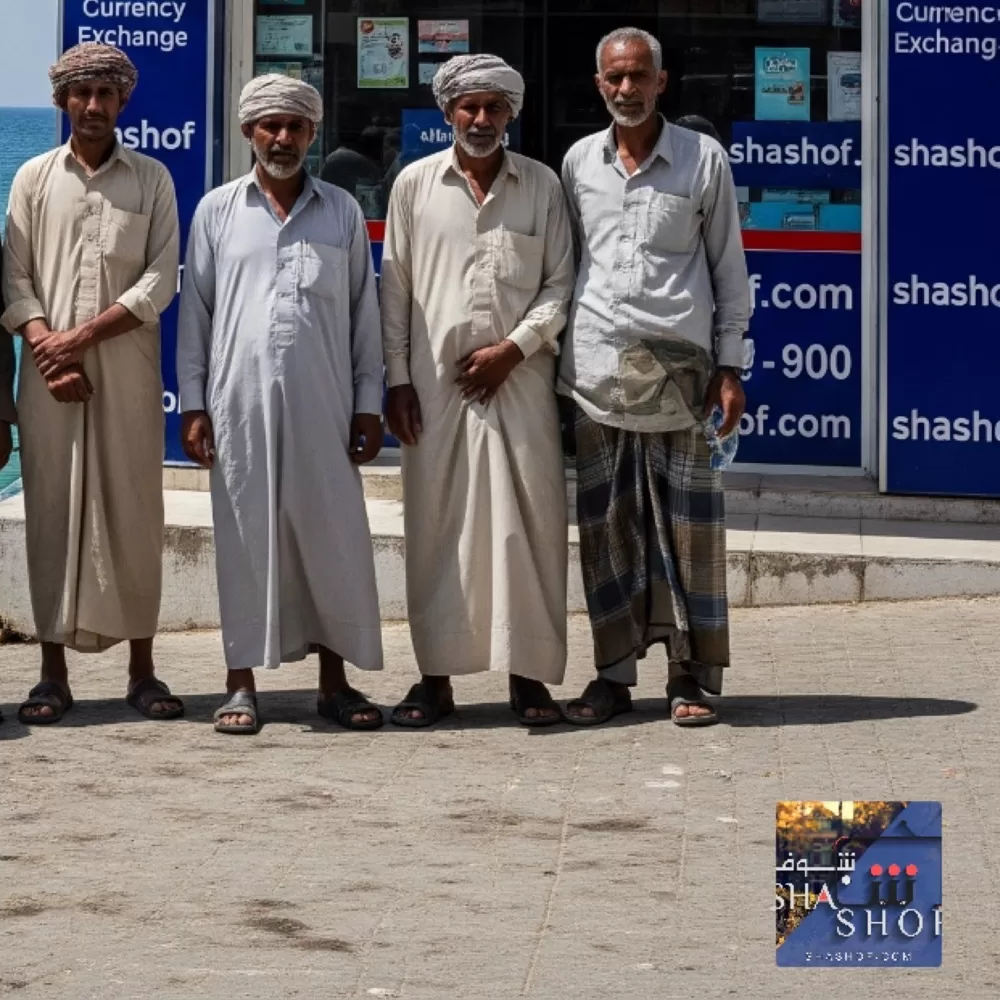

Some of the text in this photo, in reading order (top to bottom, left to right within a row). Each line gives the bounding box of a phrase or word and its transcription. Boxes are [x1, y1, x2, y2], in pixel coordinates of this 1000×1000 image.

[896, 2, 1000, 23] Currenc
[78, 25, 188, 52] Exchange
[895, 28, 1000, 61] Exchang
[748, 273, 853, 310] f.com
[739, 404, 851, 439] of.com
